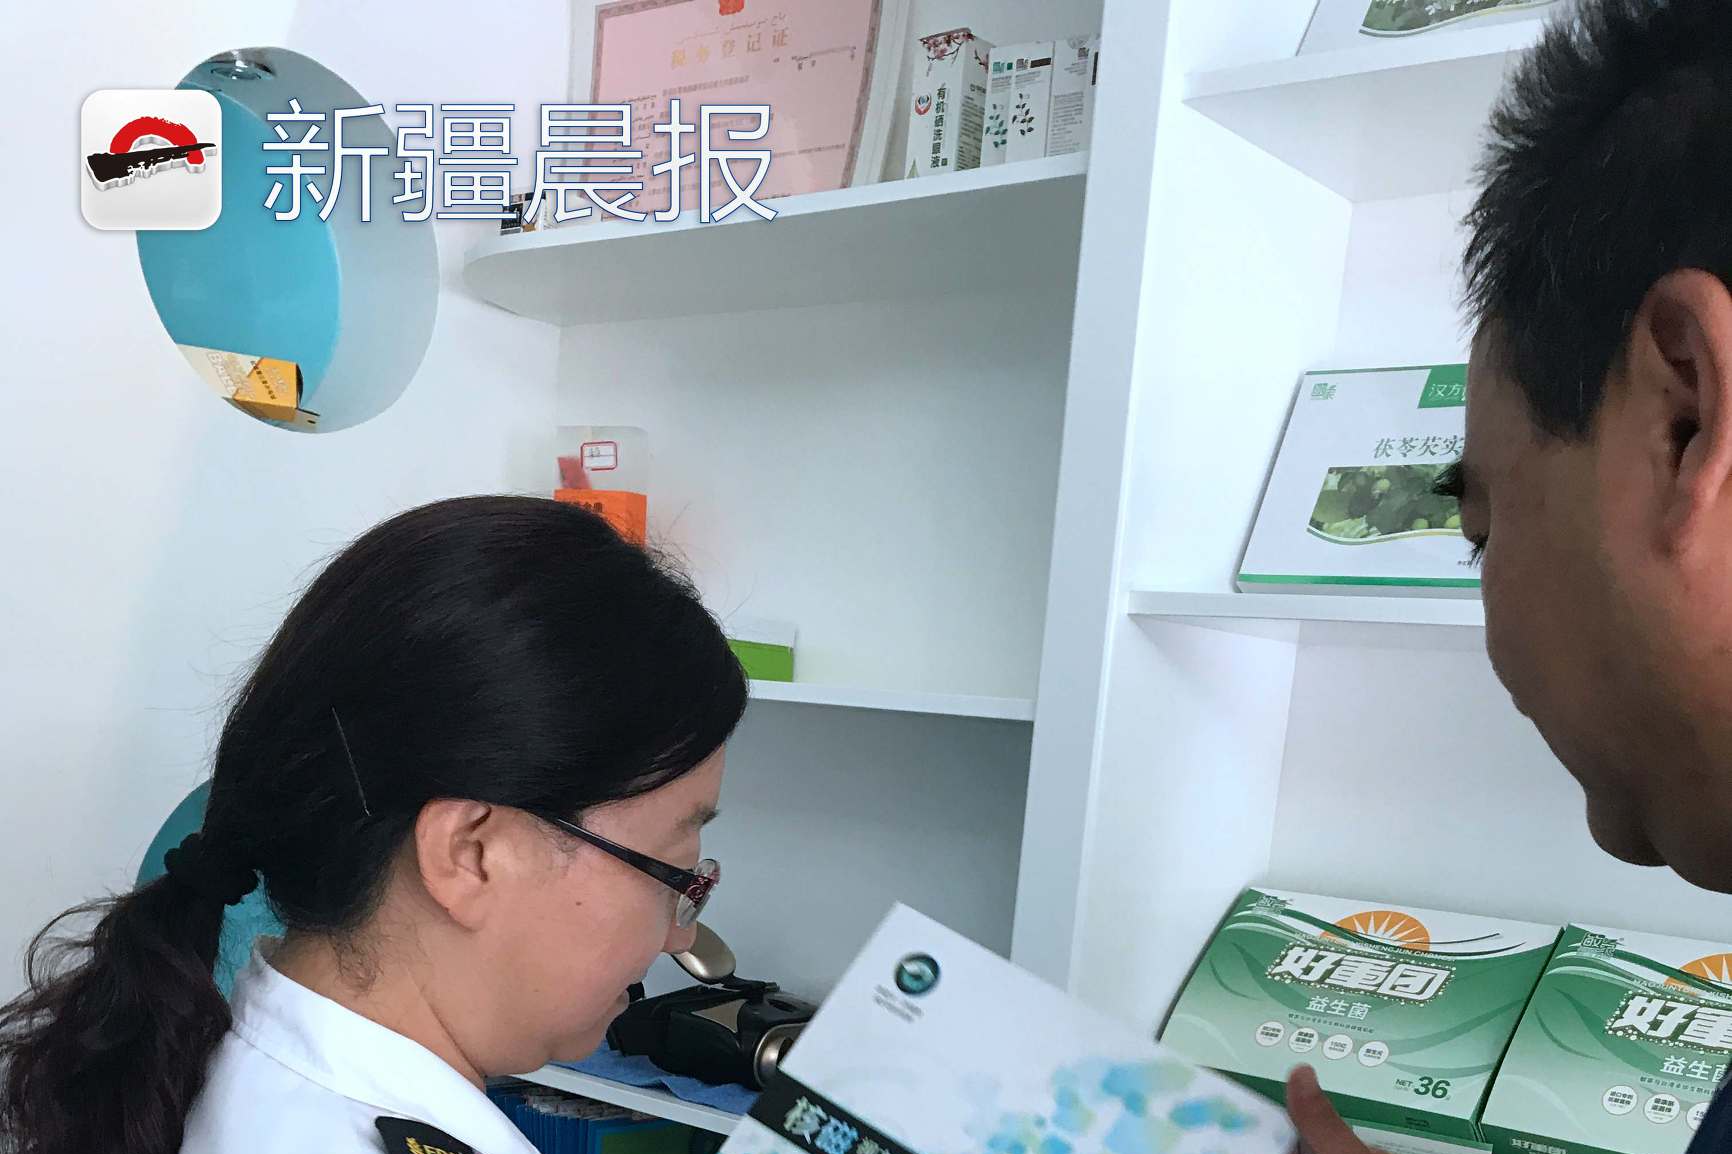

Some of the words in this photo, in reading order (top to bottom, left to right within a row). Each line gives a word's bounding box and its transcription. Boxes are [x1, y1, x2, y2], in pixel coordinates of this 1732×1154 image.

[1428, 383, 1466, 402] 汉方
[1307, 995, 1372, 1020] 益生菌
[1414, 1076, 1451, 1099] 36
